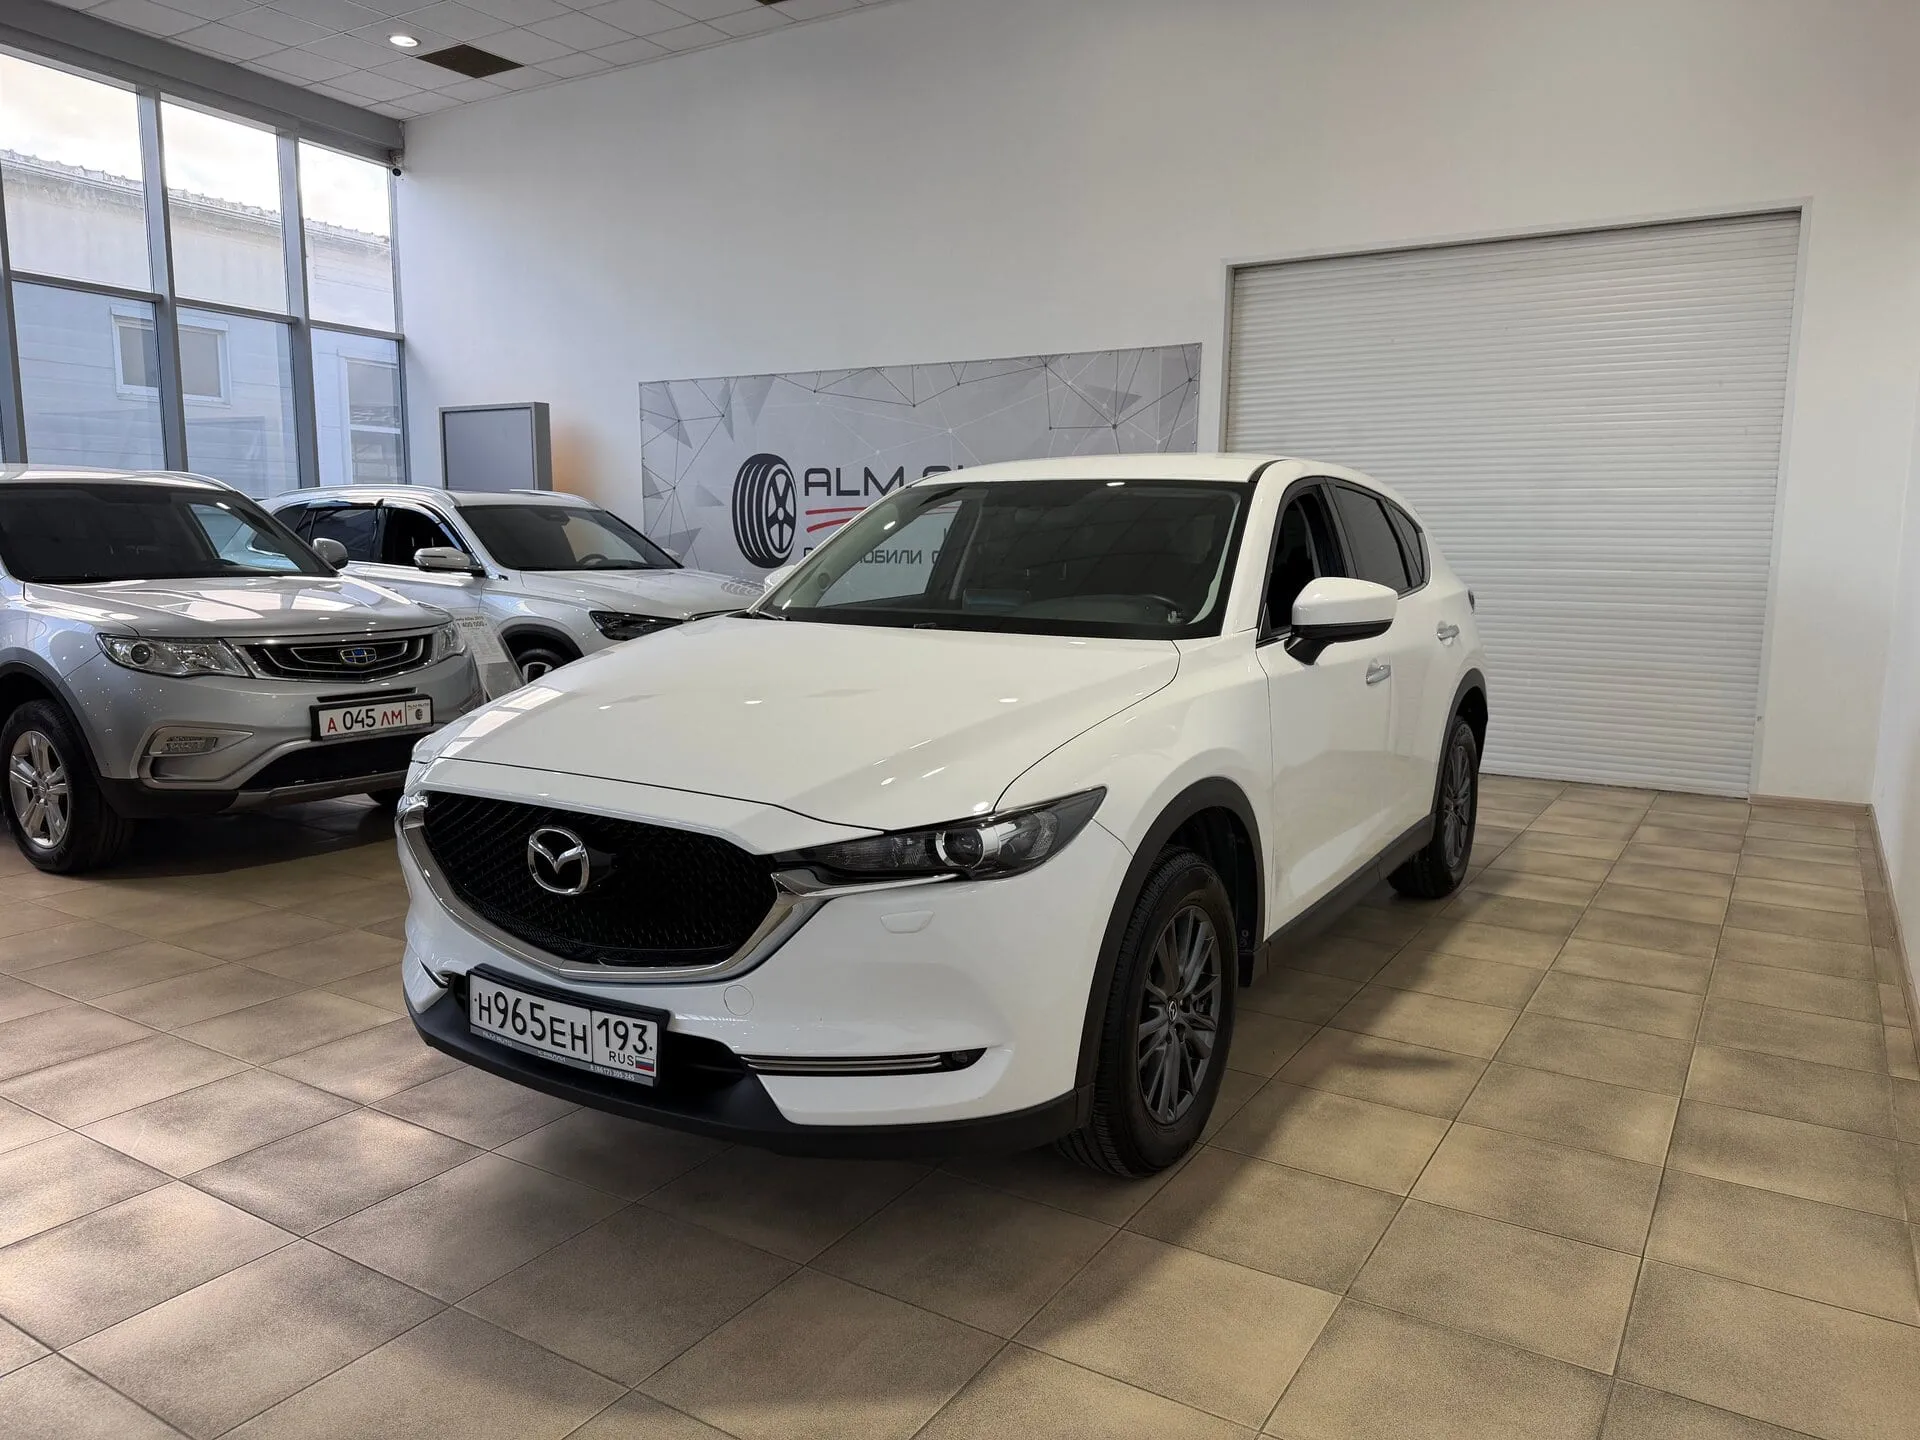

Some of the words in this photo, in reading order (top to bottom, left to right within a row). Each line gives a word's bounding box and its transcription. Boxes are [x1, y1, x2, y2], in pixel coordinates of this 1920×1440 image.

[804, 465, 904, 497] ALM
[342, 708, 376, 731] 045
[477, 990, 588, 1055] Н965ЕН
[596, 1017, 648, 1055] 193
[608, 1051, 635, 1067] RUS
